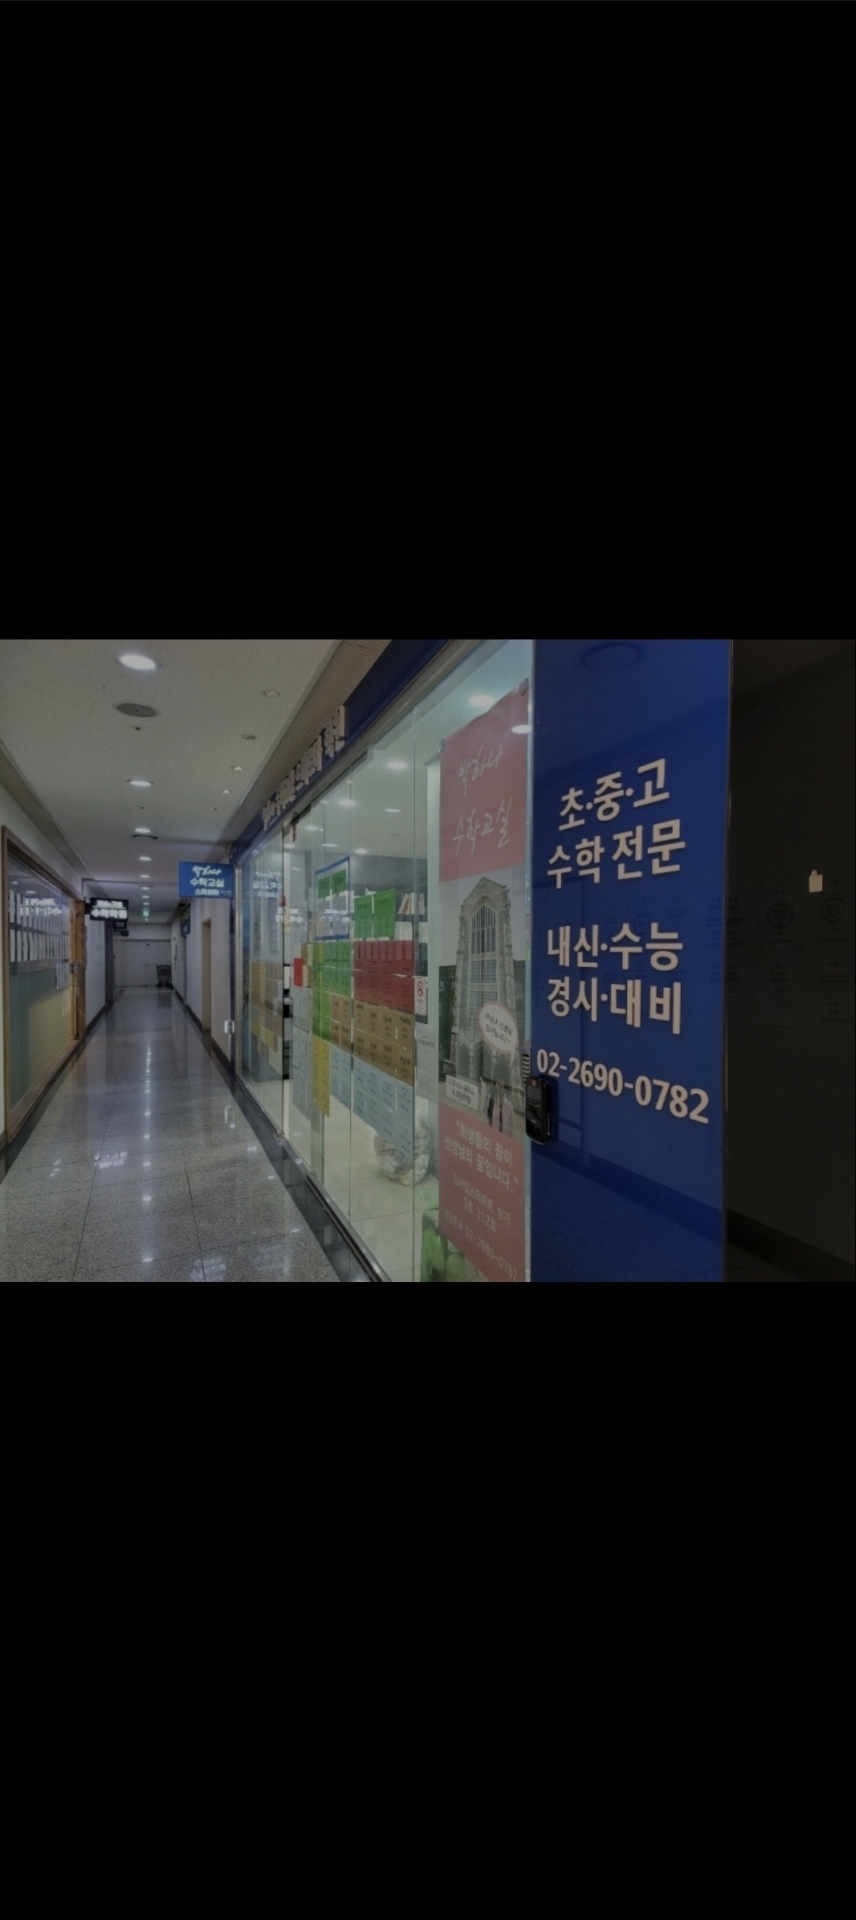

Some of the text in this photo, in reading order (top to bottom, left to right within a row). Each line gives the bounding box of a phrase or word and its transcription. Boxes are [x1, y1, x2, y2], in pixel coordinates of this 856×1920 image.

[457, 743, 505, 797] 박하나
[451, 796, 513, 857] 수학교실
[546, 818, 686, 890] 수학 전문
[190, 877, 225, 888] 수학교실
[546, 922, 684, 973] 내신·수능
[546, 976, 682, 1036] 경시·대비
[536, 1047, 710, 1124] 02-2690-0782
[444, 1134, 473, 1166] 선생님의
[494, 1142, 512, 1169] 꿈이
[476, 1206, 497, 1233] 312호
